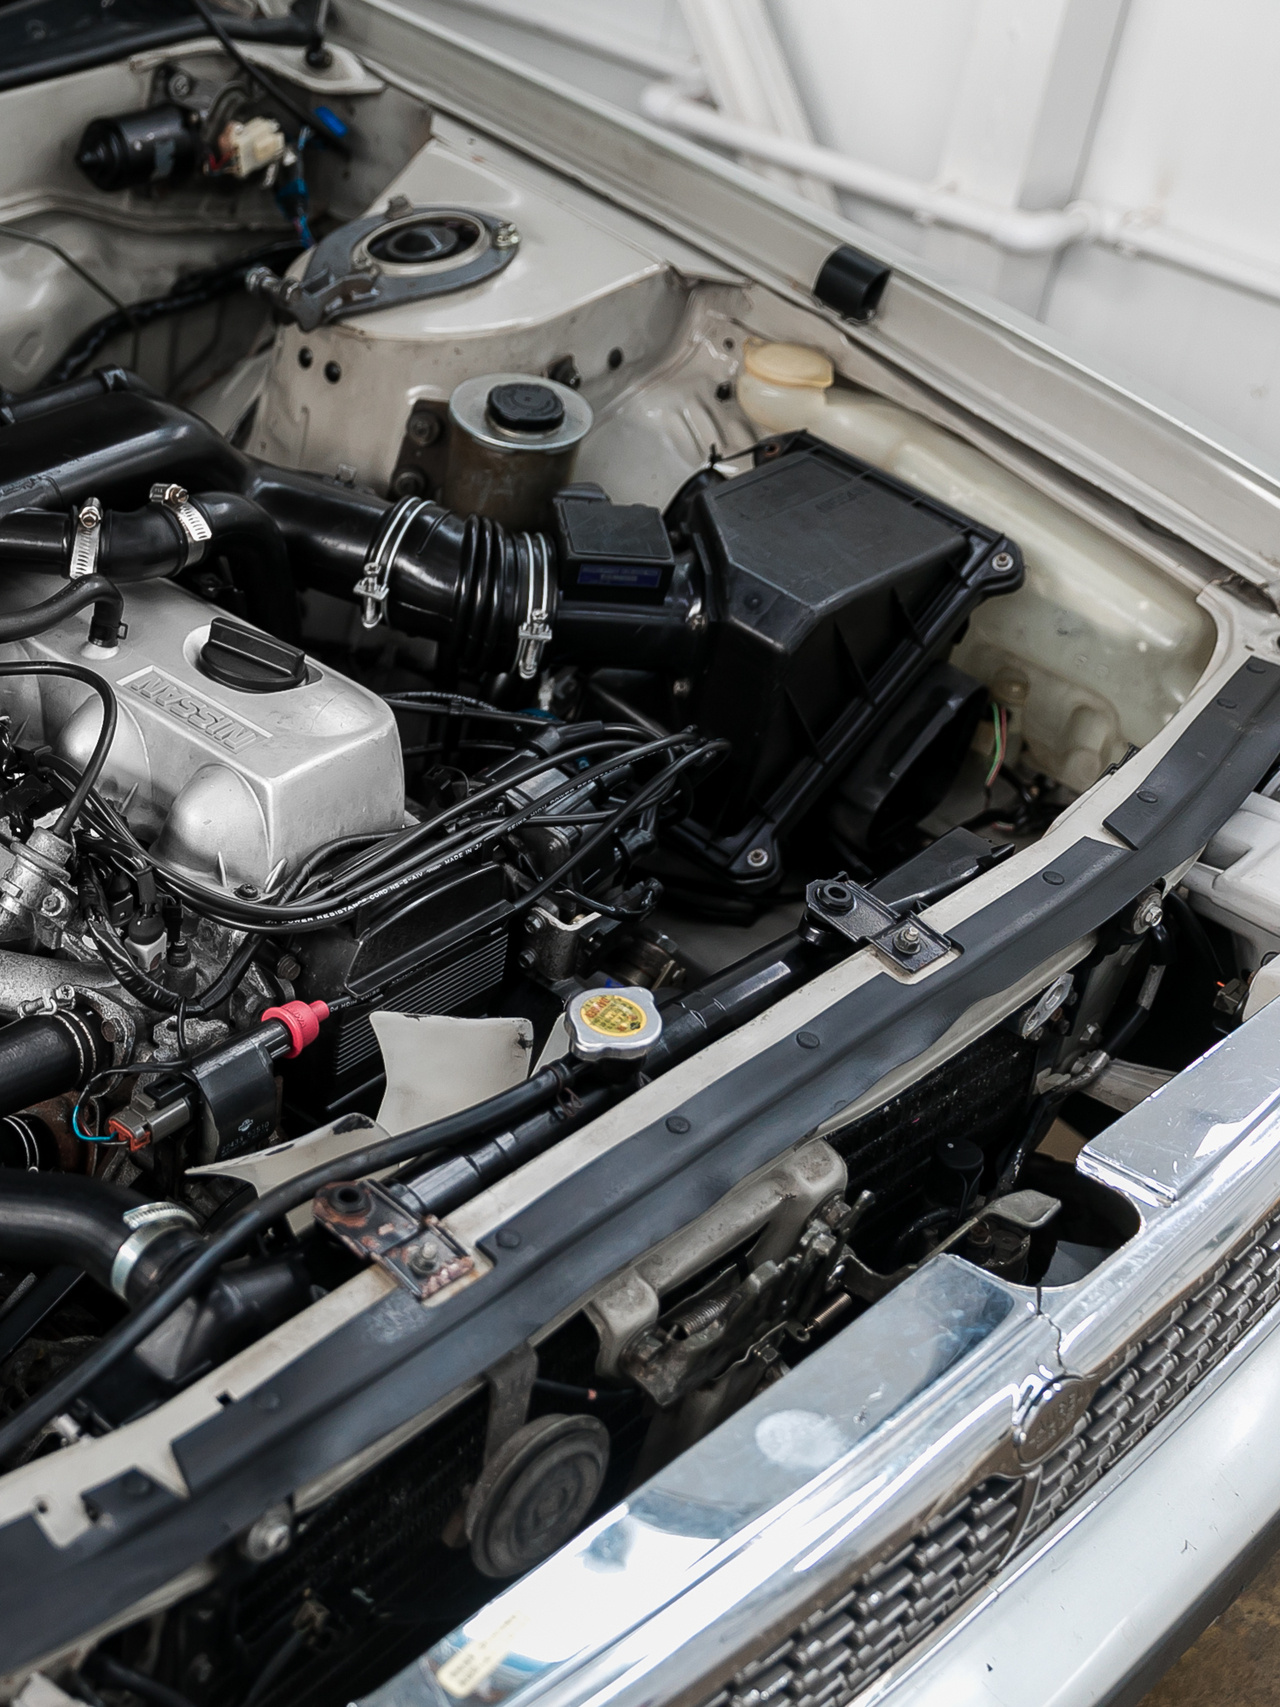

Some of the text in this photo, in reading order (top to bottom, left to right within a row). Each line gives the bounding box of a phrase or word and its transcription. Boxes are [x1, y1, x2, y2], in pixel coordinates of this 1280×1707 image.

[129, 670, 258, 749] NISSAN
[443, 847, 473, 865] MADE IN
[368, 888, 388, 900] CORD
